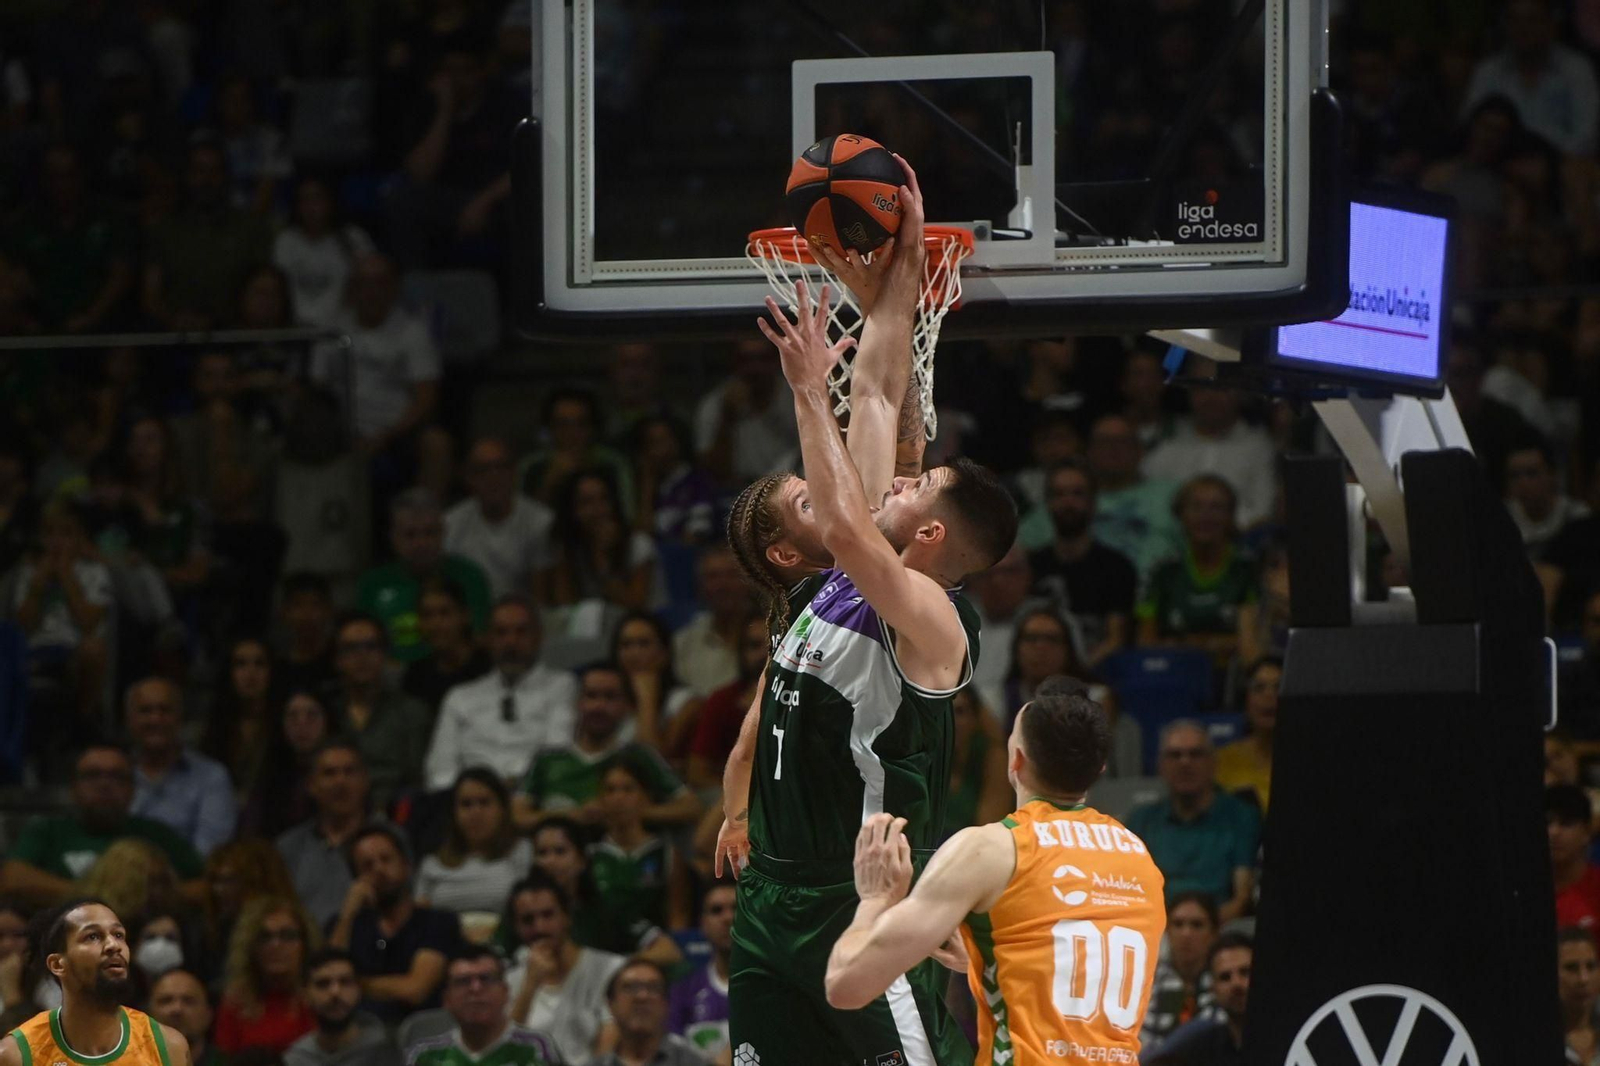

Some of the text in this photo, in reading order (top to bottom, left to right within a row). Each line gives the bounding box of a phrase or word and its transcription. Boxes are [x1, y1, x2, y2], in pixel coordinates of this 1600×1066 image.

[872, 193, 895, 212] liga
[1178, 202, 1214, 222] liga
[1178, 221, 1258, 239] endesa
[1033, 819, 1146, 854] KURUCS
[1051, 918, 1148, 1031] 00
